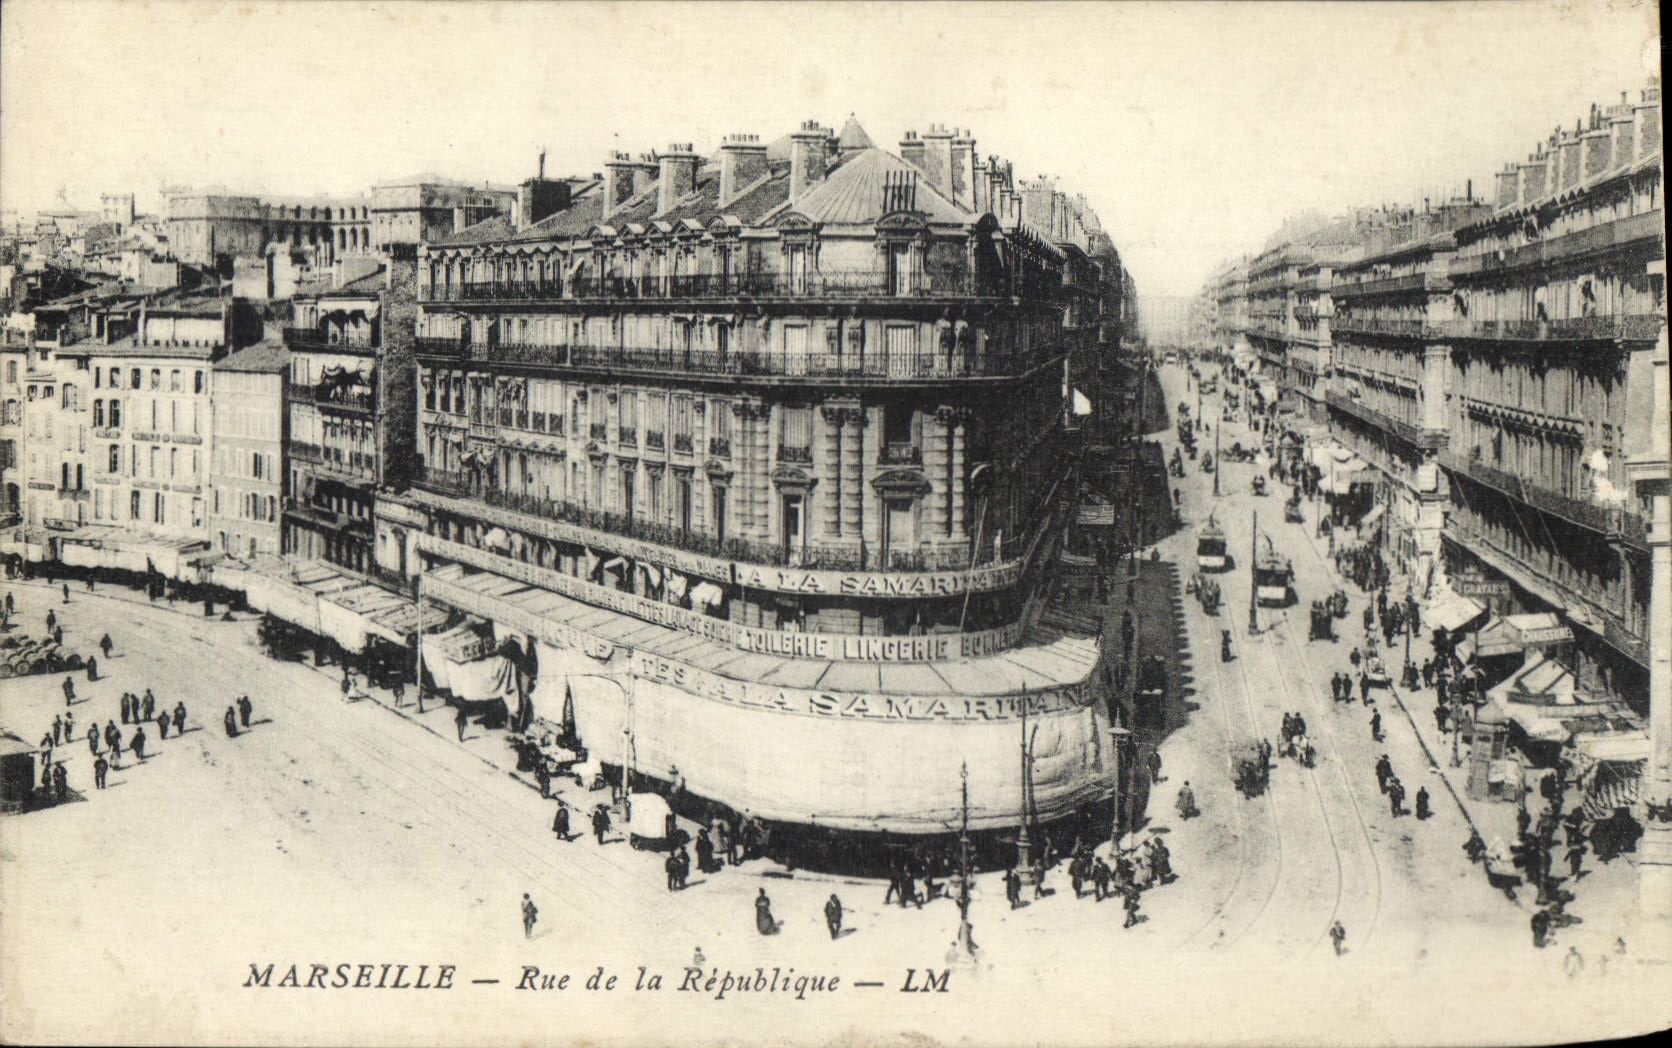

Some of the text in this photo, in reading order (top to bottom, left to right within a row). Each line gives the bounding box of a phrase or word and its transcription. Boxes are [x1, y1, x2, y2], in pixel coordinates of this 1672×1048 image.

[744, 567, 1018, 597] A LA SAMARITAINE
[746, 631, 828, 657] TOILERIE
[843, 638, 948, 661] LINGERIE
[739, 685, 800, 711] LA
[808, 684, 1094, 720] SAMARITAINE
